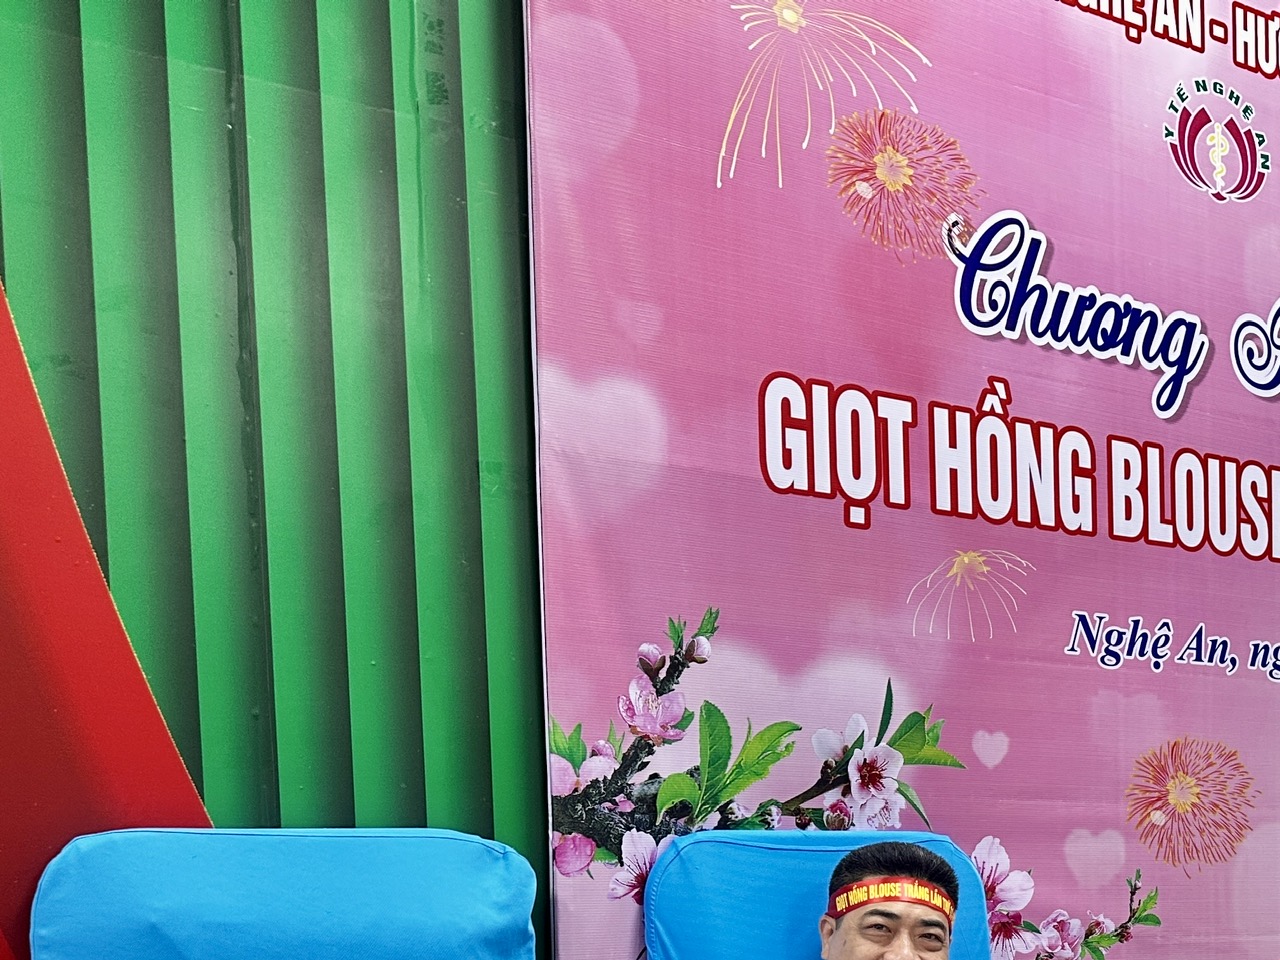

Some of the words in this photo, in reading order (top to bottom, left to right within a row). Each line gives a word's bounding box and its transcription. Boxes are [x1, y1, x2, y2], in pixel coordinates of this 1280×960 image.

[1168, 82, 1190, 114] TẾ
[1193, 79, 1255, 122] NGHỆ
[1254, 132, 1271, 171] AN
[946, 216, 1204, 414] Chương
[762, 374, 915, 526] GIỌT
[931, 380, 1096, 533] HỒNG
[1067, 612, 1173, 671] Nghệ
[1178, 625, 1238, 674] An,
[869, 882, 902, 899] BLOUSE
